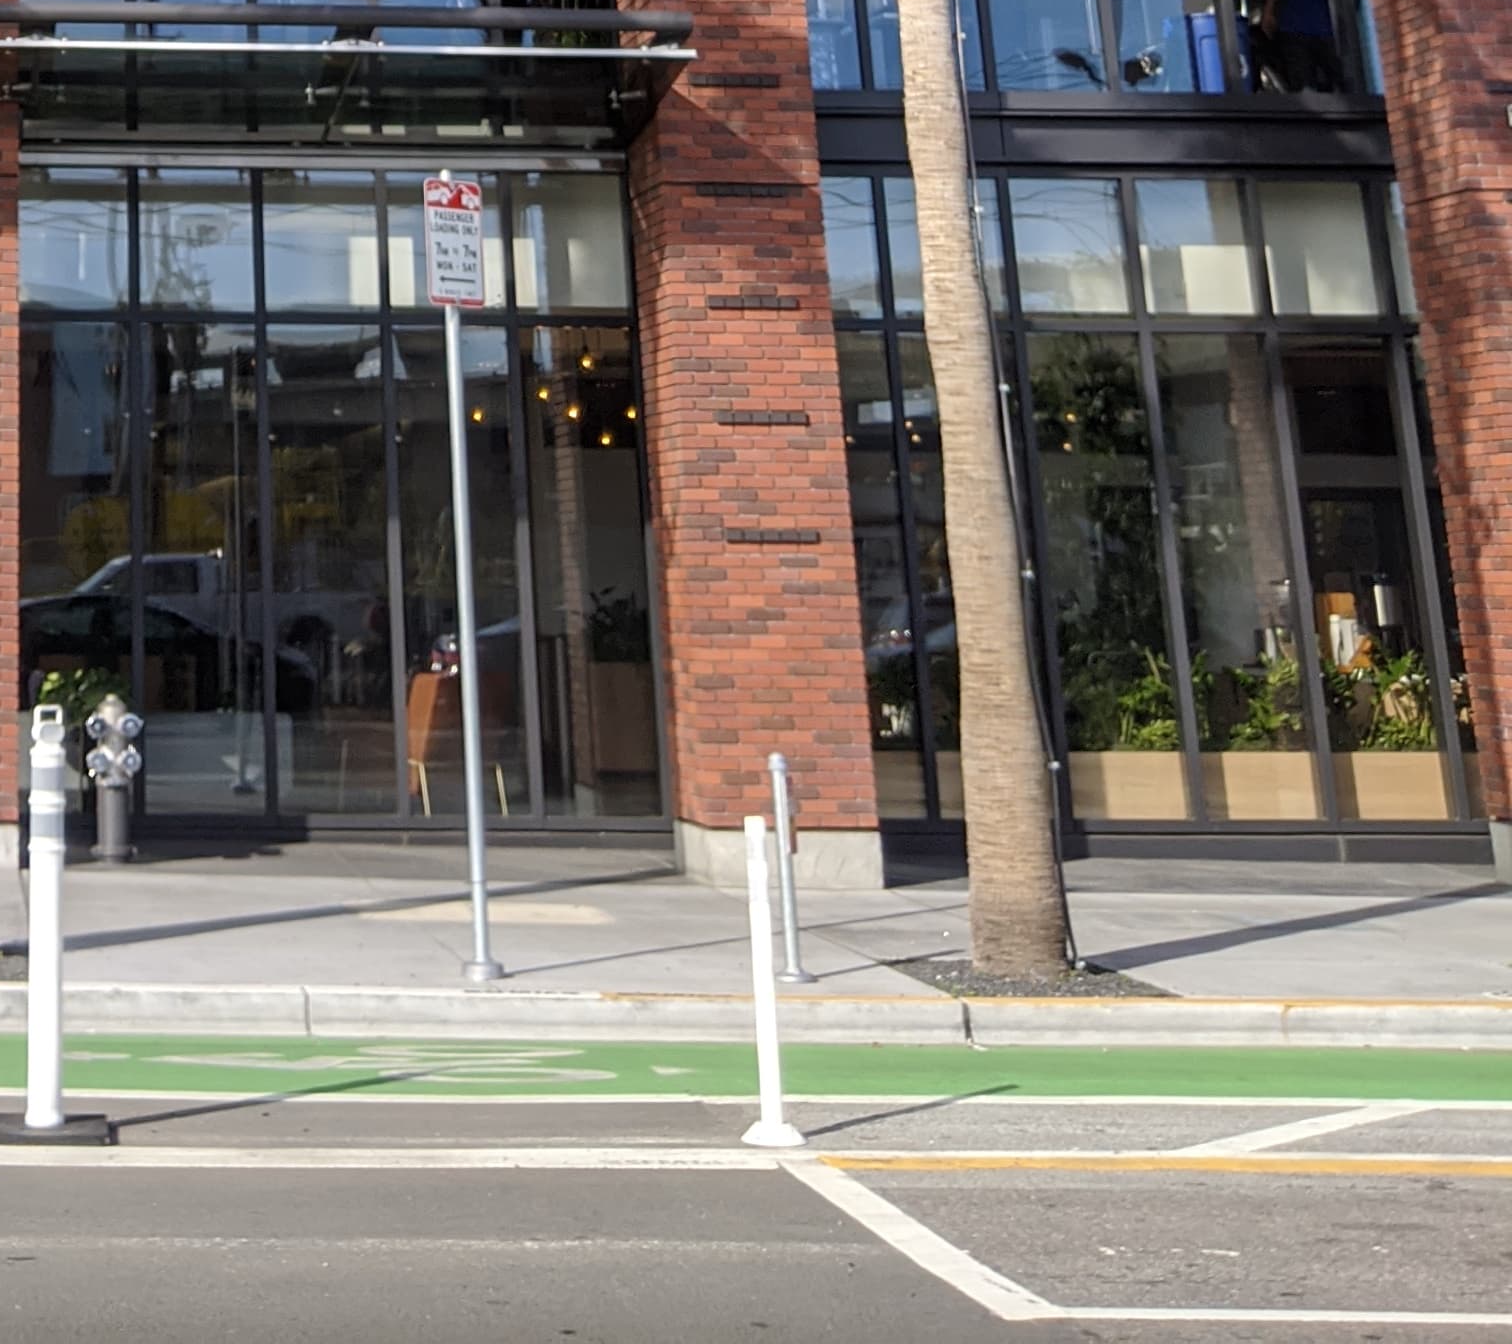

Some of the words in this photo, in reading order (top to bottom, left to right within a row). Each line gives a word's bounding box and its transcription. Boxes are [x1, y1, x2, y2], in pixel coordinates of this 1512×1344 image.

[434, 210, 474, 224] PASSENGER
[462, 224, 478, 236] ONLY
[462, 262, 477, 273] SAT
